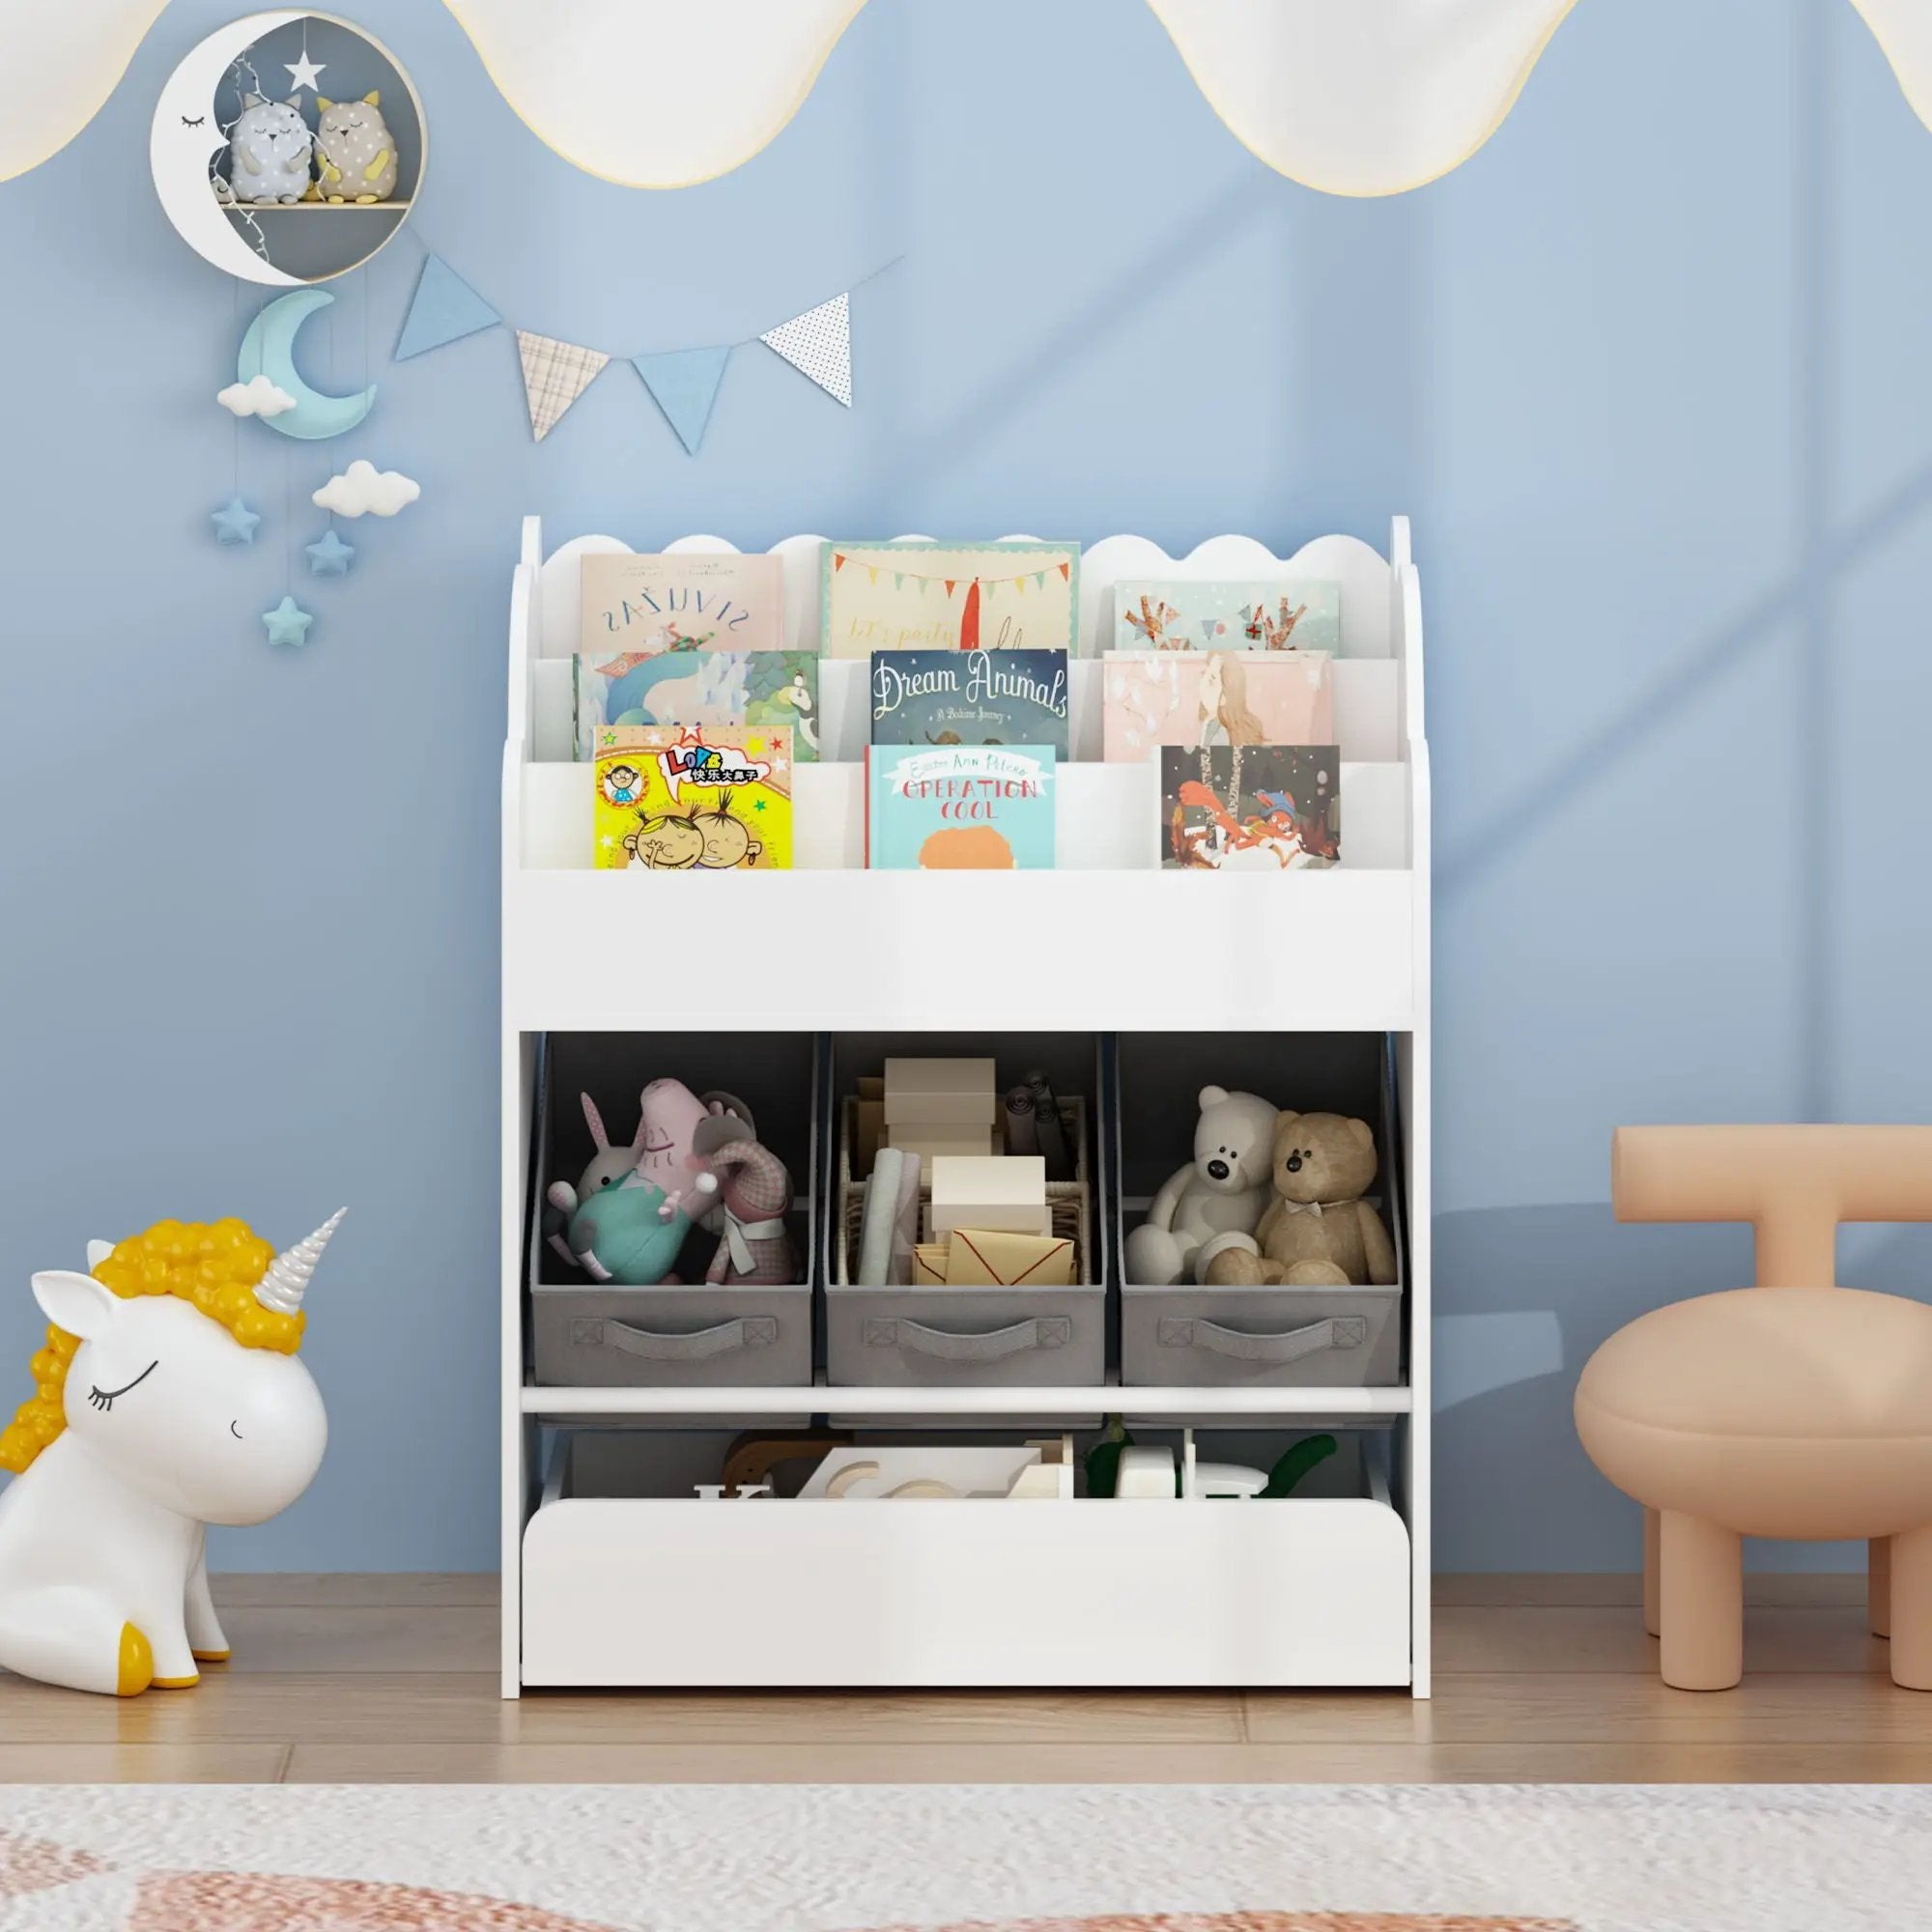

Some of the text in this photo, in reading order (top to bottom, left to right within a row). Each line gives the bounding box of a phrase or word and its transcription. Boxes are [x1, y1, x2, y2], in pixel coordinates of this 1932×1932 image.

[872, 648, 1067, 721] Dream Animals
[691, 769, 758, 781] 快乐大鼻子
[902, 780, 1037, 798] OPERATION
[941, 801, 998, 820] COOL
